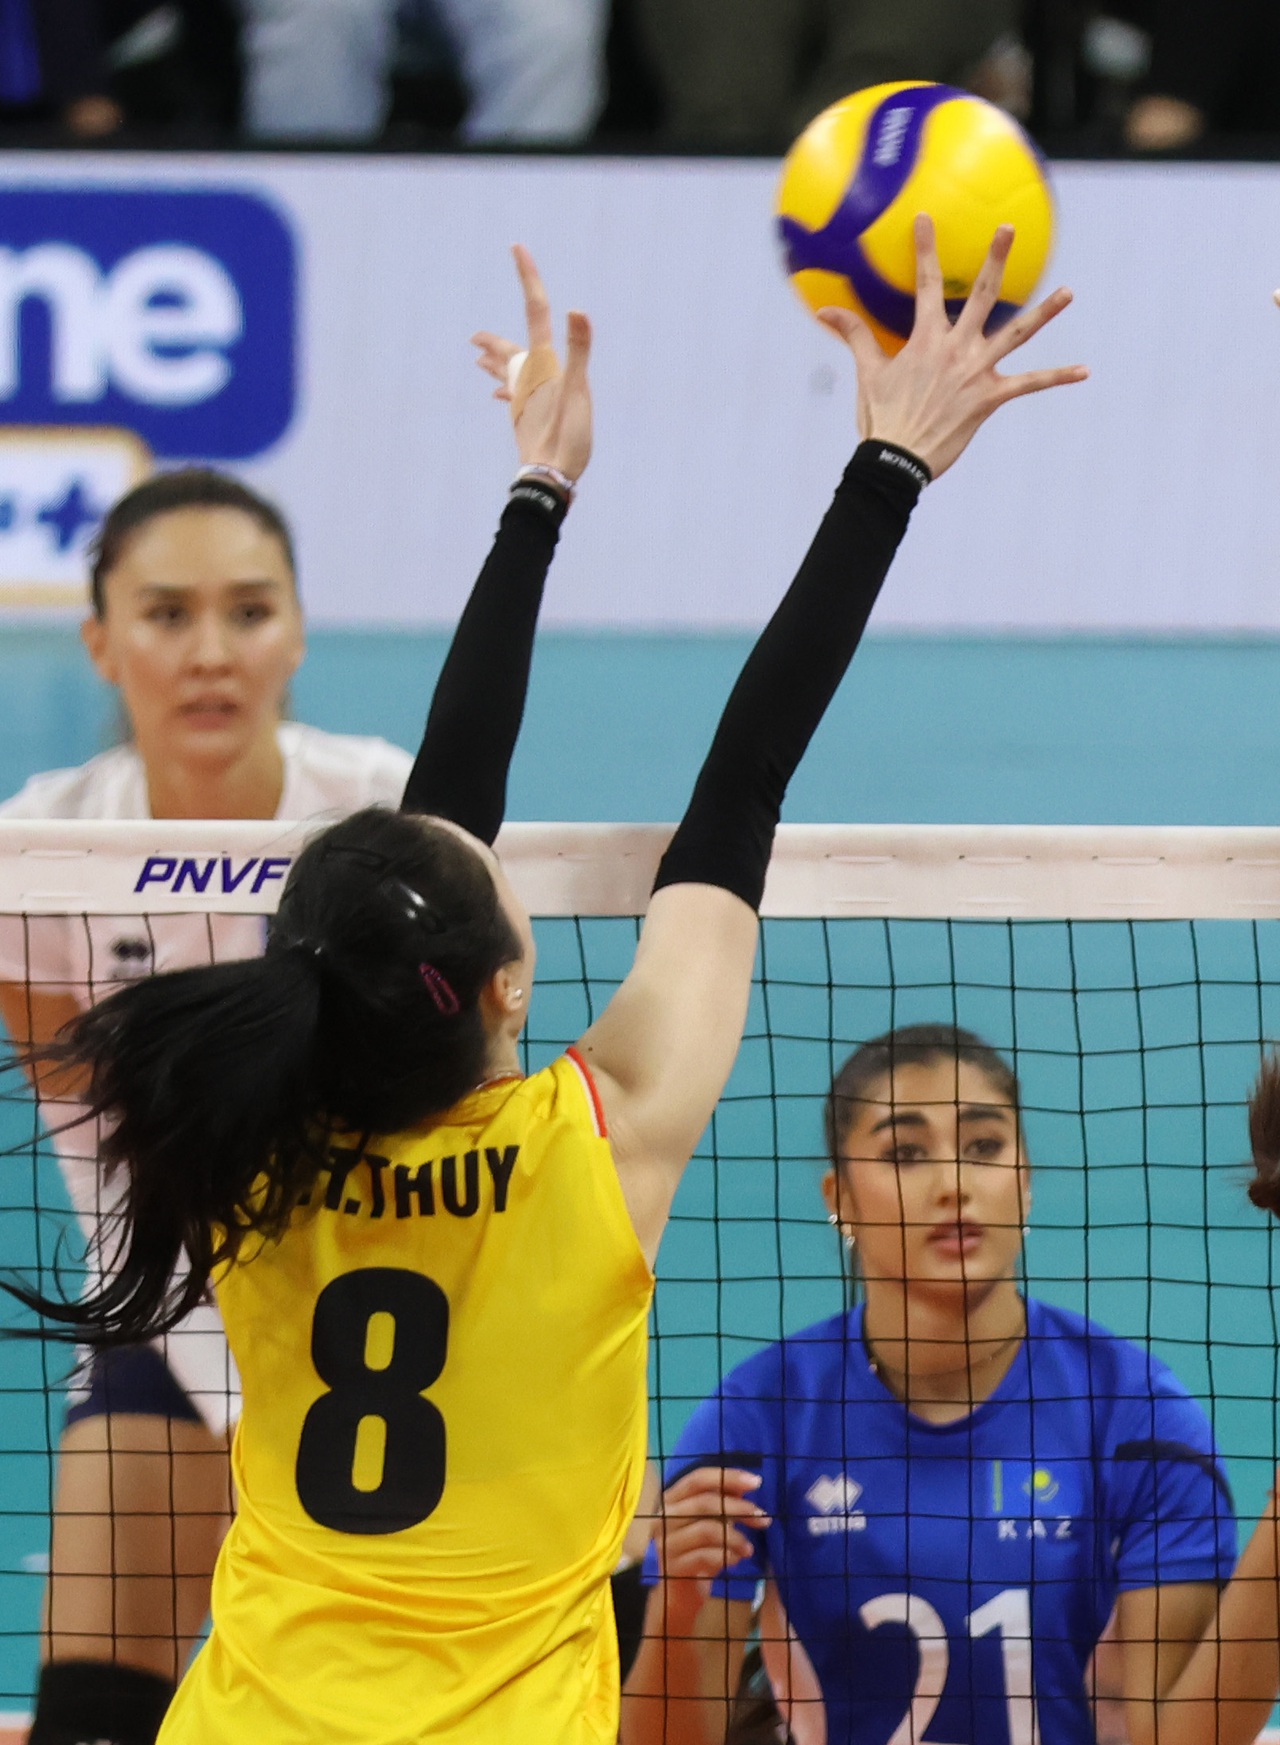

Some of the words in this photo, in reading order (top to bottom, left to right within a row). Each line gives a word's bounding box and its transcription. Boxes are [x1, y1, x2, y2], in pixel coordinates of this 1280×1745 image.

[0, 243, 243, 405] ne
[133, 857, 292, 894] PNVF
[295, 1266, 450, 1535] 8
[858, 1588, 1042, 1745] 21
